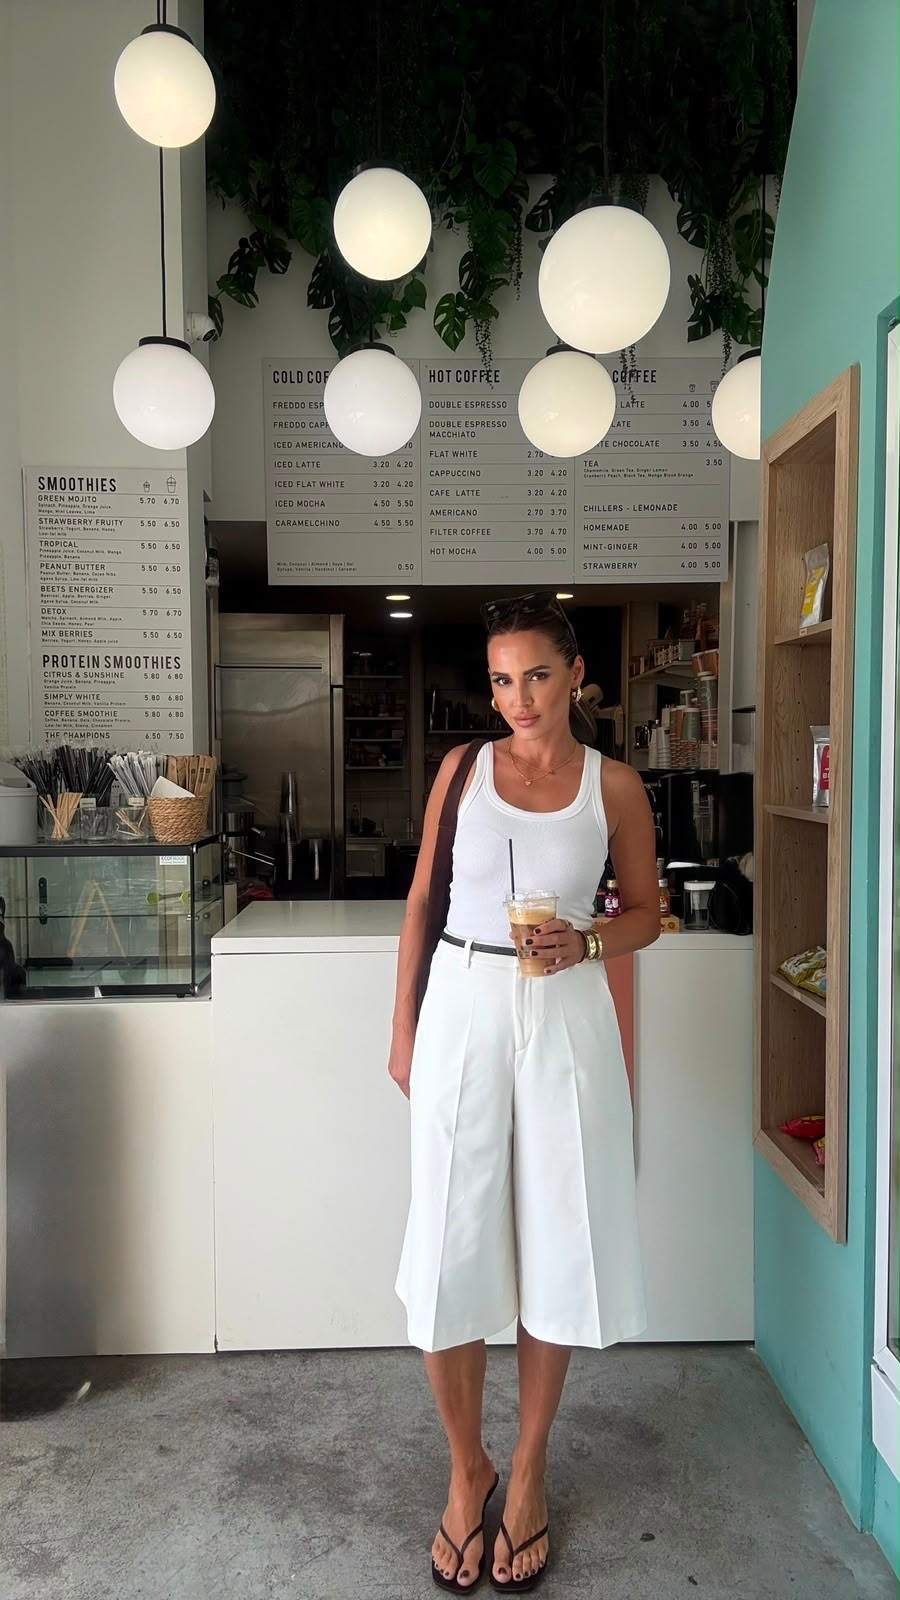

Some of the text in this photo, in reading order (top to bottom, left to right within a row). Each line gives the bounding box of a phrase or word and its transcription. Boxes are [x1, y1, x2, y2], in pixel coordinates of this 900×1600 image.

[273, 370, 329, 384] COLD COF
[429, 370, 500, 383] HOT COFFEE
[612, 370, 657, 383] COFFEE
[429, 401, 507, 409] DOUBLE ESPRESSO
[429, 450, 478, 458] FLAT WHITE
[38, 476, 116, 492] SMOOTHIES
[40, 540, 78, 548] TROPICAL
[583, 562, 638, 570] STRAWBERRY
[69, 586, 114, 594] ENERGIZER
[42, 654, 181, 670] PROTEIN SMOOTHIES
